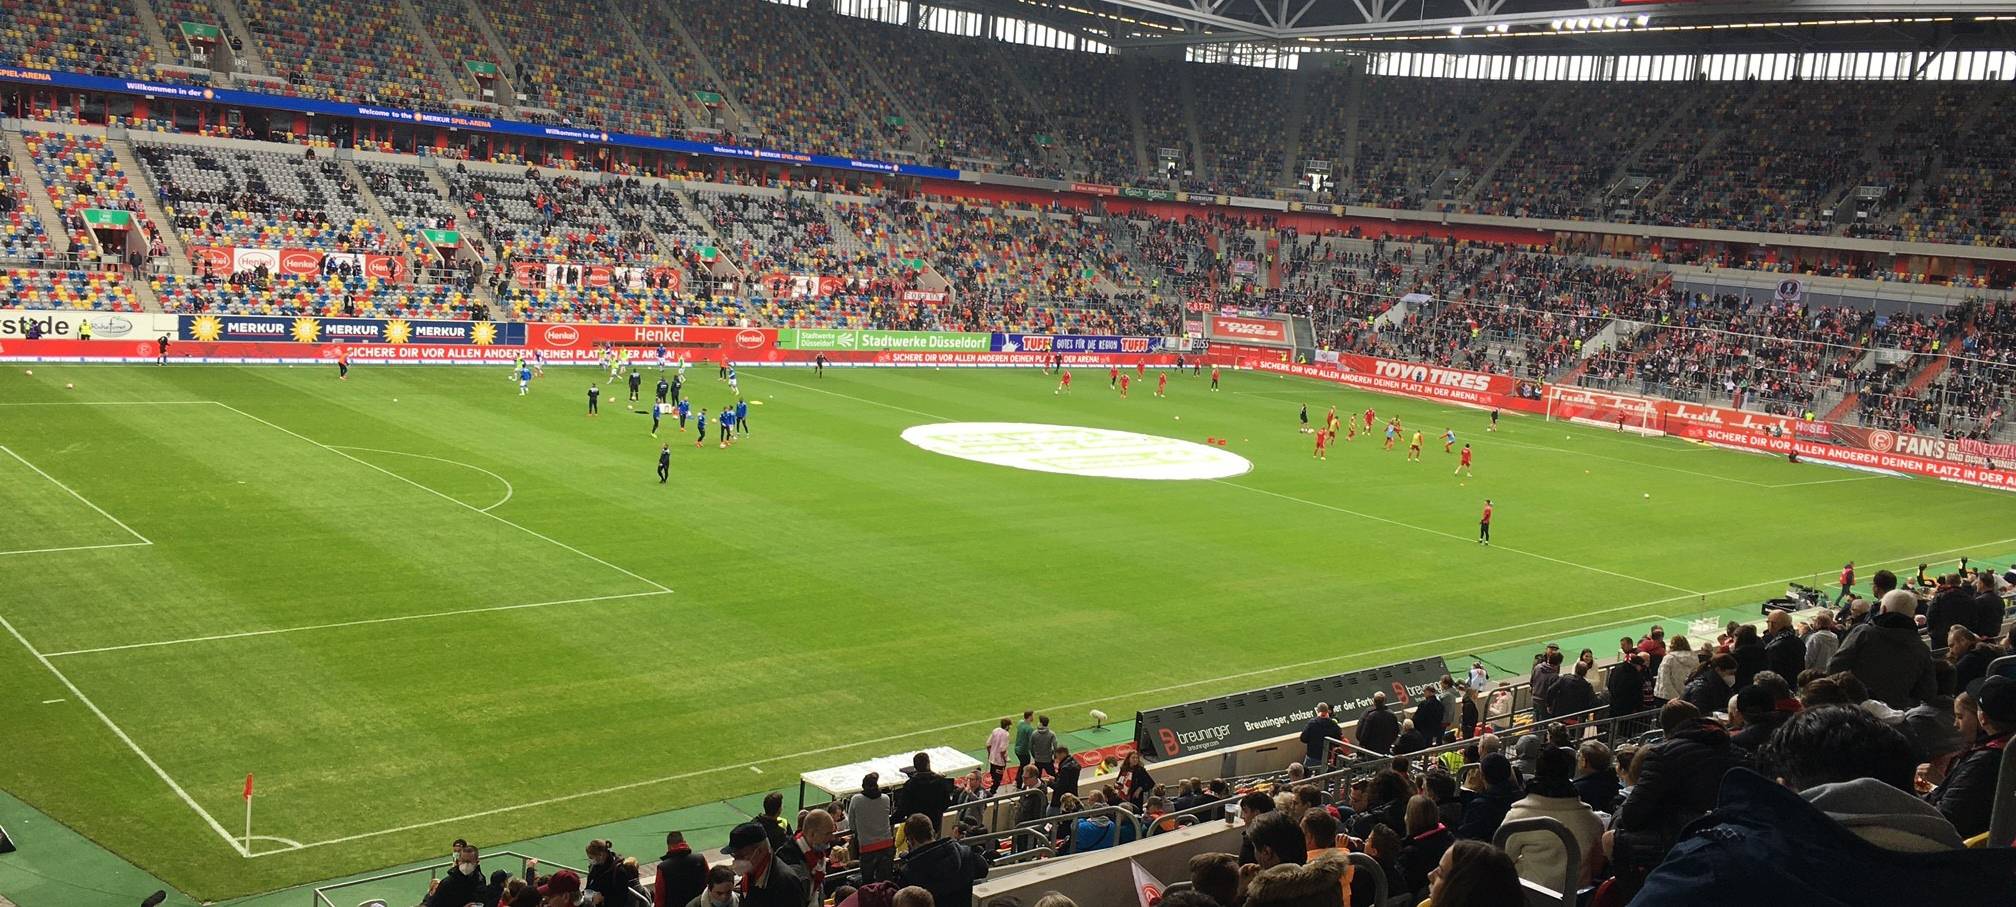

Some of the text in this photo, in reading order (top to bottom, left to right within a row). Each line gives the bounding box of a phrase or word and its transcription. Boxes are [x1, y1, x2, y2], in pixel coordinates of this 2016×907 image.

[127, 82, 202, 97] Willkommen in der
[358, 107, 390, 118] Welcome
[401, 112, 412, 120] the
[423, 114, 450, 123] MERKUR
[545, 128, 582, 138] Willkommen
[241, 257, 272, 267] Henkel
[286, 259, 316, 269] Henkel
[227, 322, 285, 333] MERKUR
[325, 324, 378, 335] MERKUR
[416, 326, 465, 337] MERKUR
[1217, 321, 1264, 331] TOYO
[547, 331, 576, 341] Henkel
[635, 328, 684, 342] Henkel
[1228, 328, 1279, 337] TIRES
[738, 333, 763, 344] Henkel
[801, 339, 836, 348] Düsseldorf
[862, 334, 986, 349] Stadtwerke Düsseldorf
[1099, 339, 1118, 350] REGION
[348, 346, 395, 358] SICHERE
[399, 347, 418, 358] DIR
[421, 348, 445, 358] VOR
[447, 348, 482, 358] ALLEN
[576, 350, 604, 359] PLAT
[892, 353, 923, 362] SICHERE
[924, 353, 936, 362] DIR
[938, 353, 952, 362] VOR
[954, 354, 975, 362] ALLEN
[977, 354, 1009, 363] ANDEREN
[1010, 354, 1034, 363] DEINEN
[1063, 355, 1077, 363] DER
[1260, 360, 1478, 402] SICHERE DIR VOR ALLEN ANDEREN DEINEN PLATZ IN DER ARENA!
[1375, 360, 1491, 391] TOYO TIRES
[1895, 435, 1946, 459] FANS
[1960, 438, 2016, 459] MEINERZHA
[1706, 429, 1748, 444] SICHERE
[1750, 437, 1767, 446] DIR
[1768, 438, 1792, 450] VOR
[1794, 444, 1826, 456] ALLEN
[1828, 448, 1879, 464] ANDEREN
[1881, 456, 1924, 471] DEINEN
[1926, 463, 1961, 477] PLATZ
[1963, 469, 1976, 480] IN
[1979, 472, 2004, 483] DER
[1947, 452, 1964, 463] UND
[1244, 714, 1290, 732] Breuninger,
[1290, 709, 1314, 723] stolzer
[1343, 701, 1356, 712] der
[1356, 697, 1376, 710] Fort
[1176, 723, 1231, 745] breuninger
[1187, 740, 1221, 752] breuninger.com
